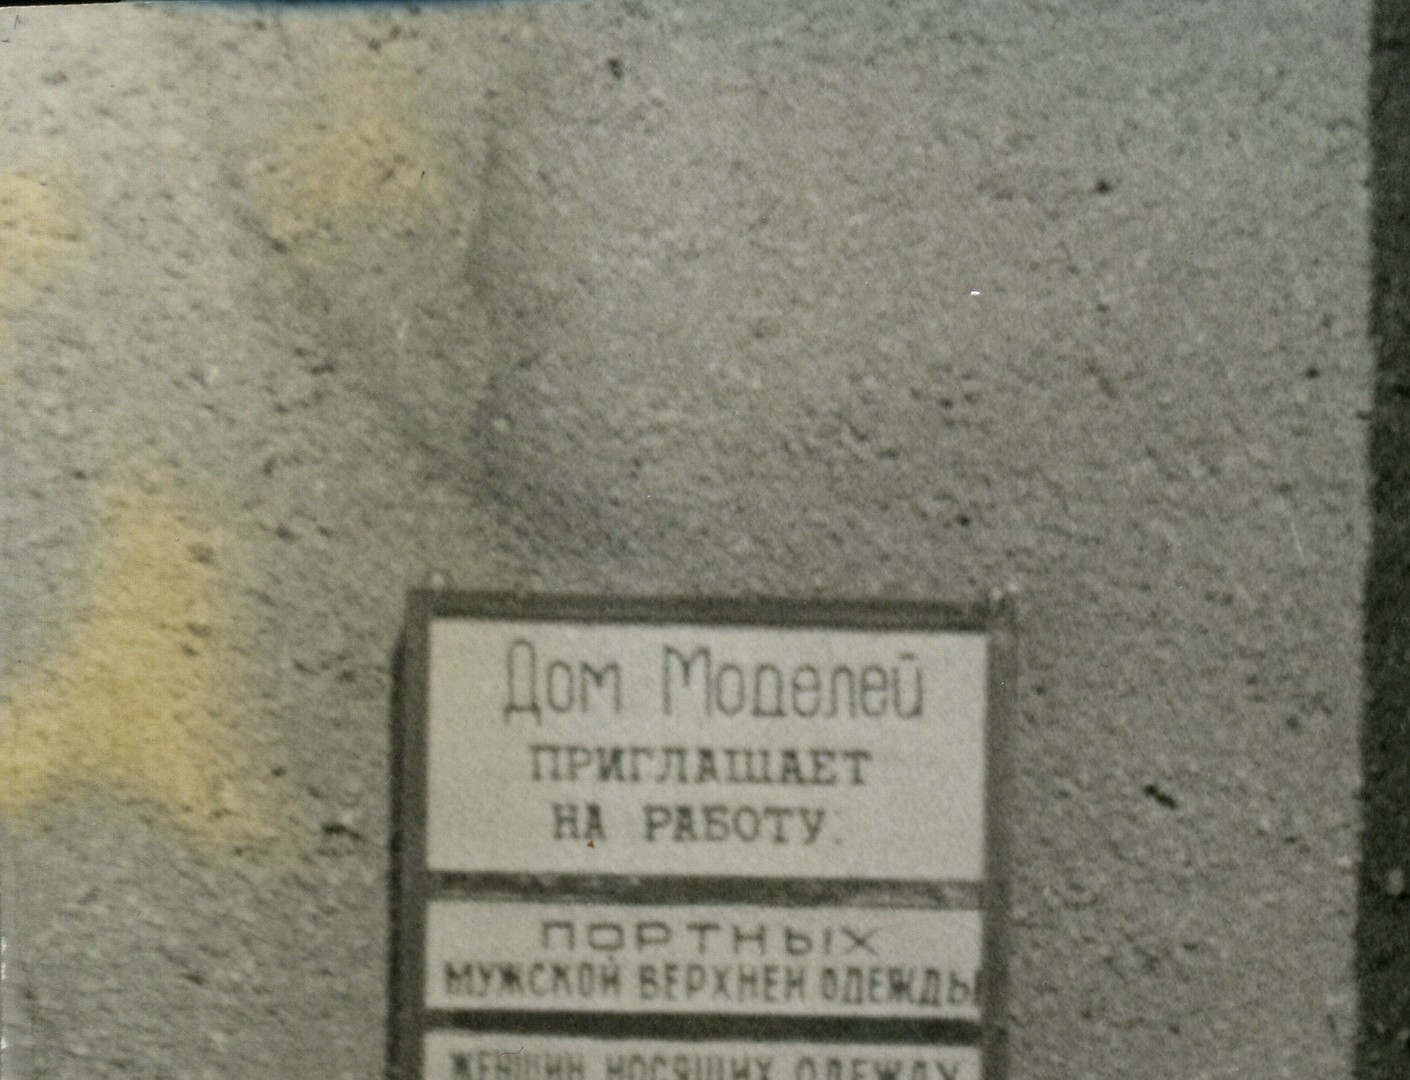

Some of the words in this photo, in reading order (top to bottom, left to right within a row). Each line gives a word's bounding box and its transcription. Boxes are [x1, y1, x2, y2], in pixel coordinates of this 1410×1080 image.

[503, 638, 623, 726] Дом
[661, 643, 926, 721] Моделей
[528, 743, 873, 787] ПРИГЛАШАЕТ
[550, 802, 608, 841] НА
[540, 919, 884, 957] ПОРТНЫХ
[444, 953, 621, 999] МУЖСКОЙ
